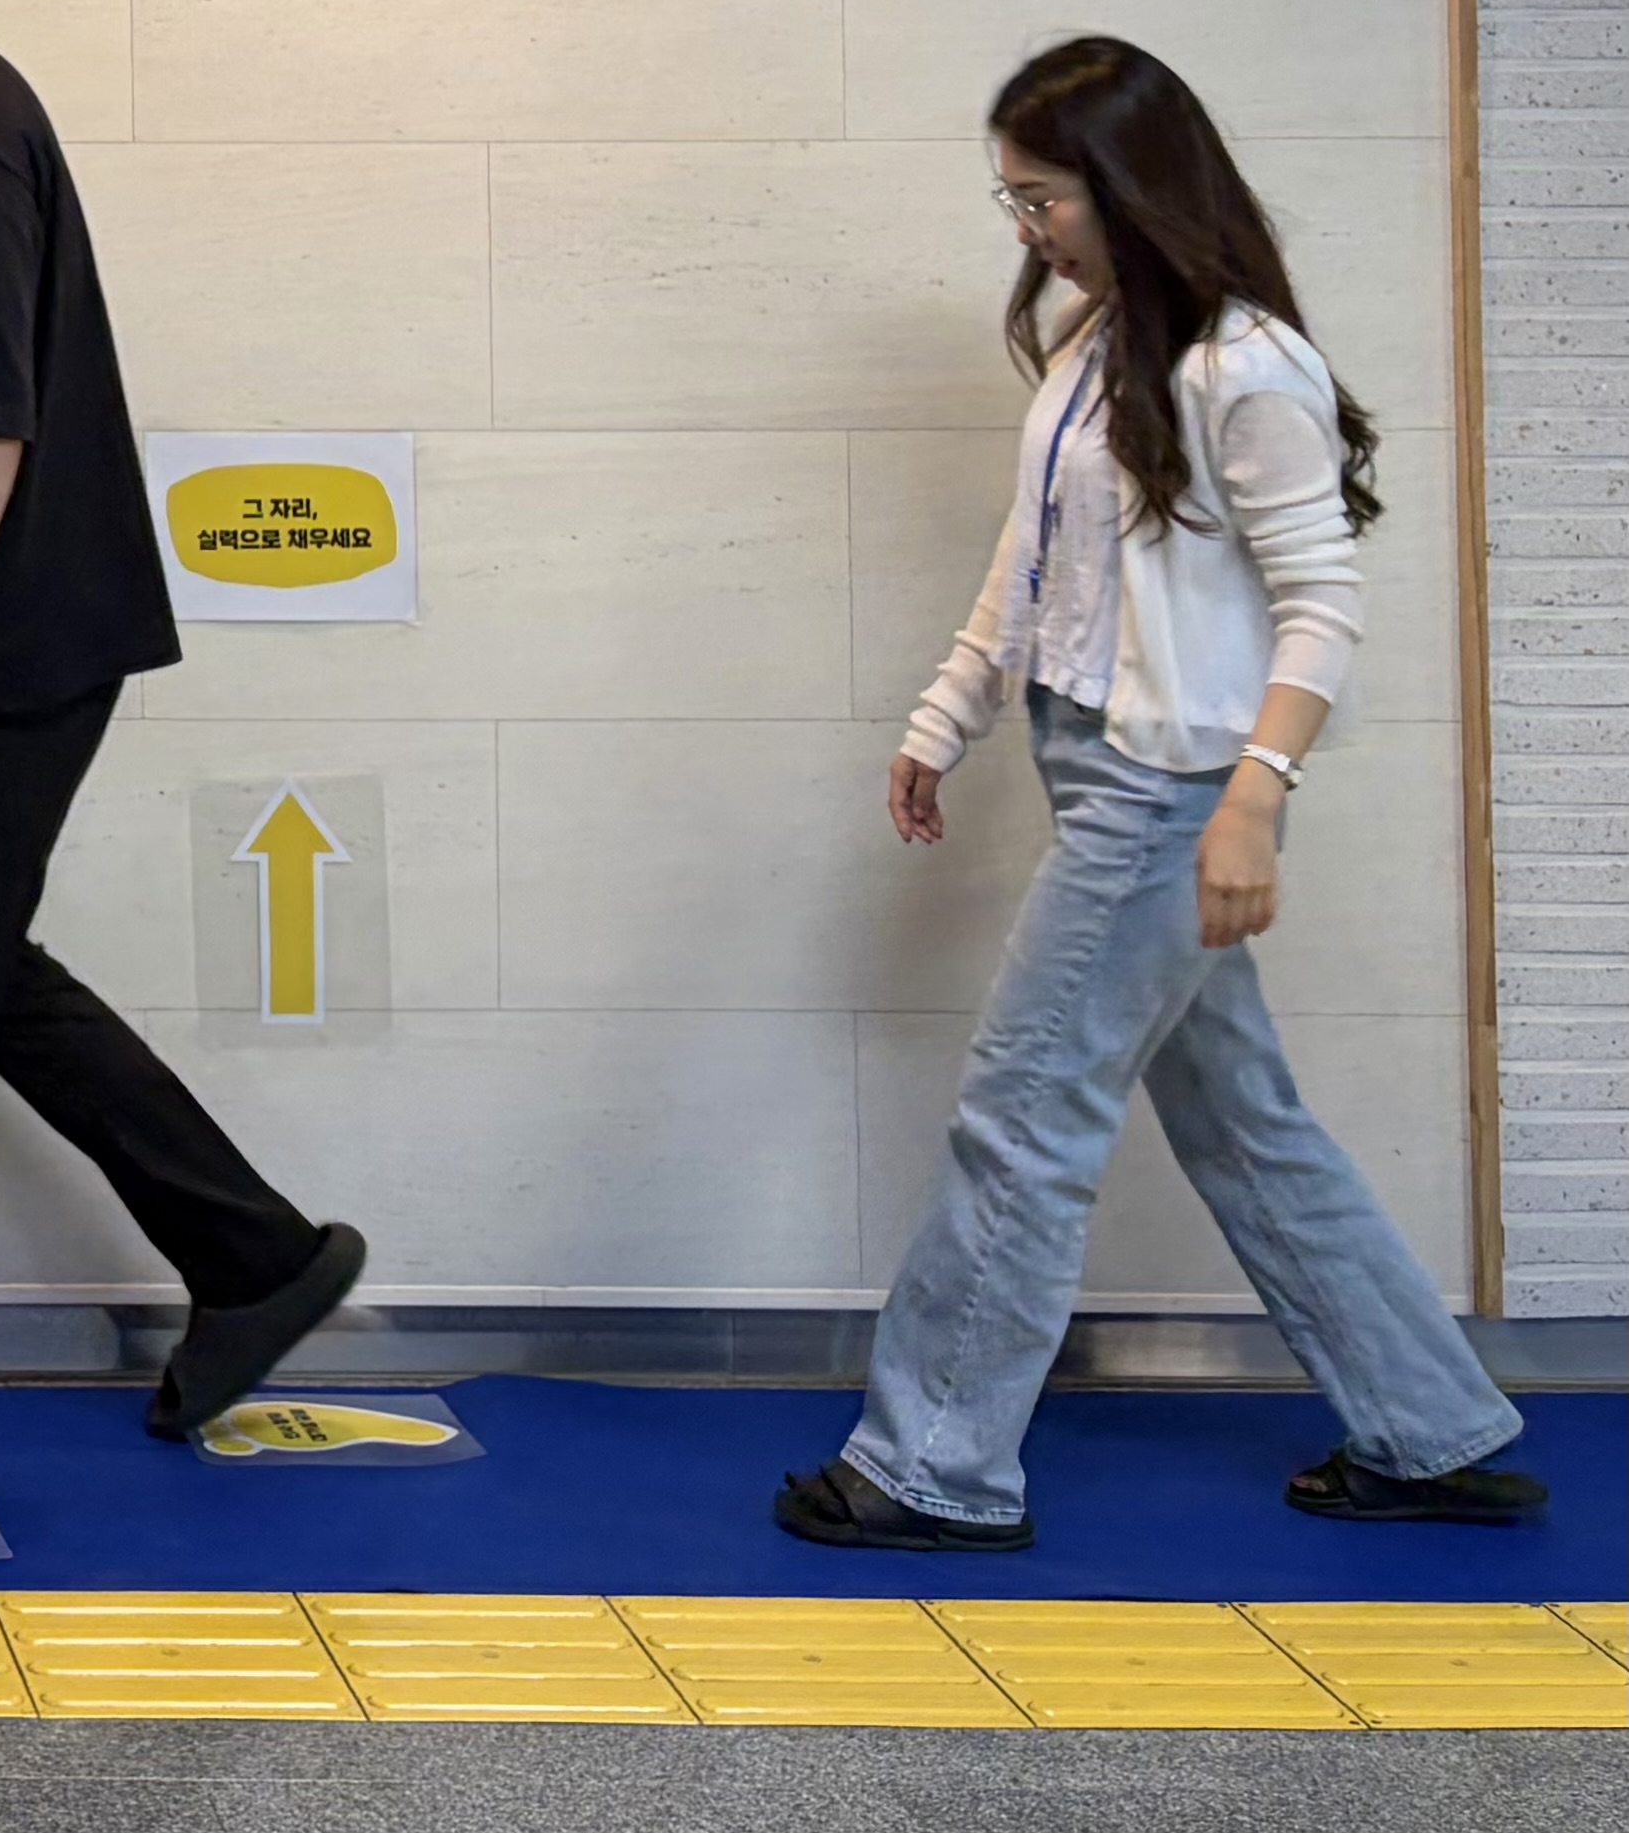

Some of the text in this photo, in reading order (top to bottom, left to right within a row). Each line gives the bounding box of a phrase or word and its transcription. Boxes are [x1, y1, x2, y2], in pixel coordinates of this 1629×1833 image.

[243, 498, 317, 520] 그 자리,
[198, 528, 371, 550] 실력으로 채우세요
